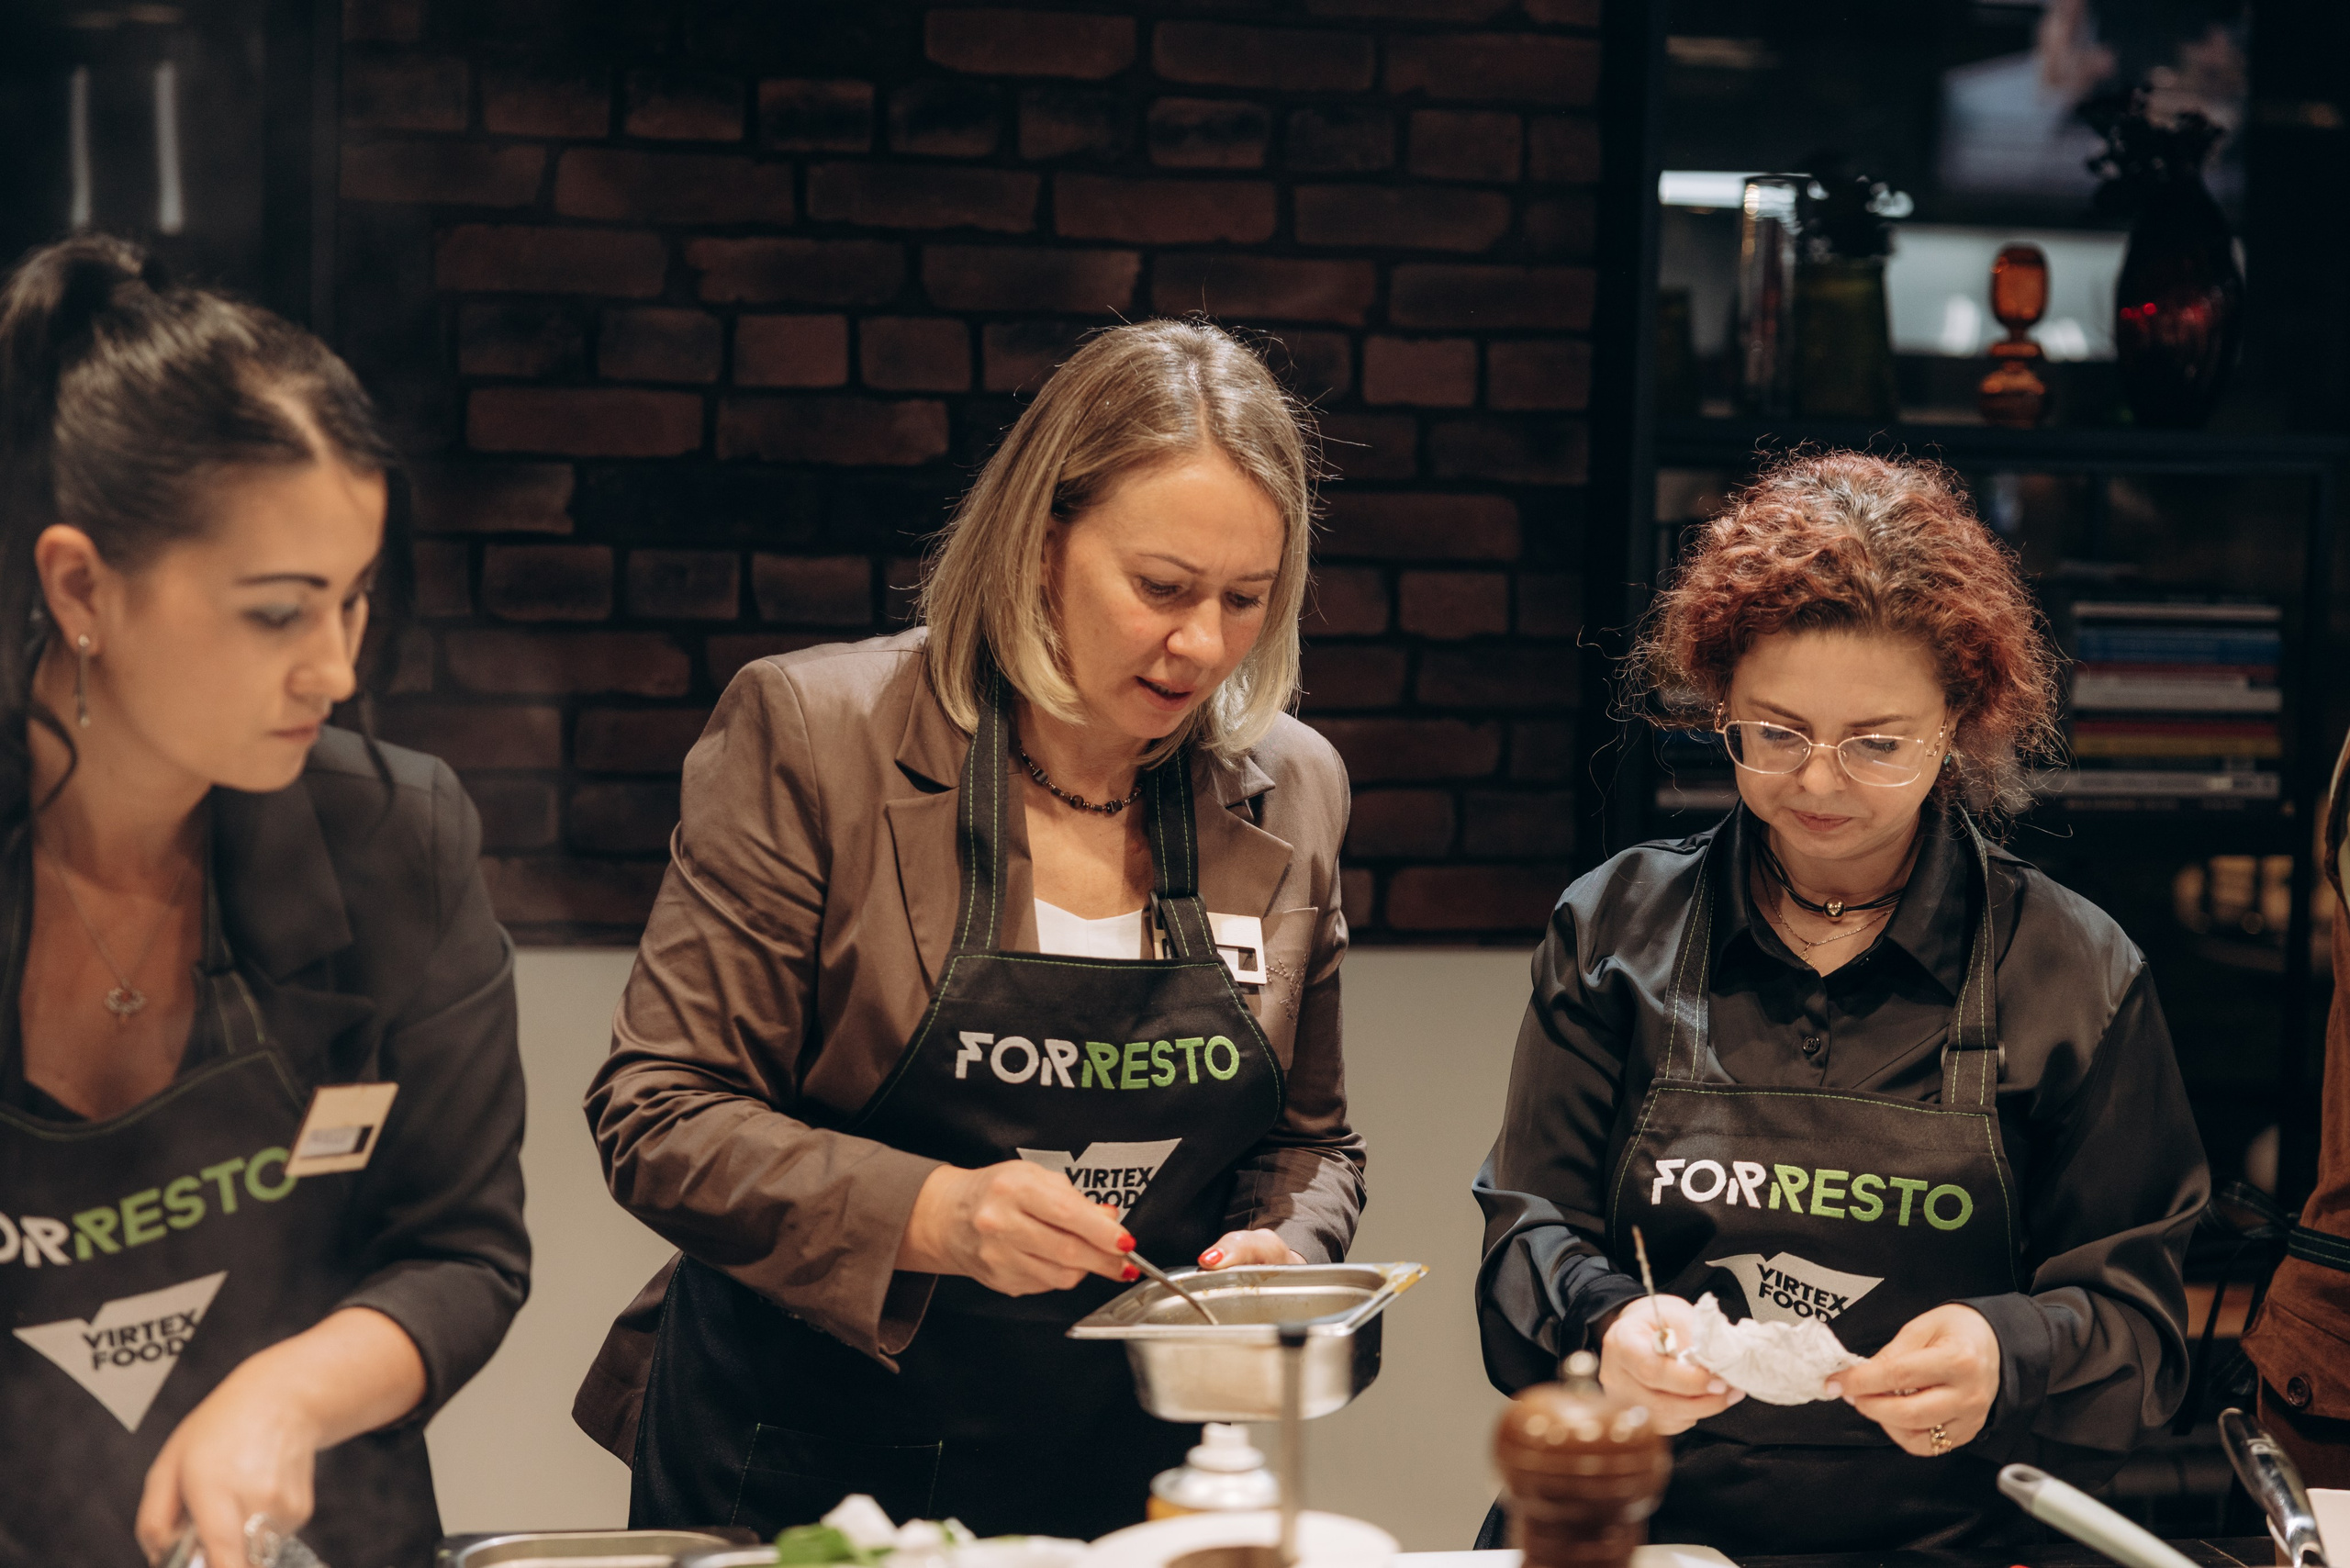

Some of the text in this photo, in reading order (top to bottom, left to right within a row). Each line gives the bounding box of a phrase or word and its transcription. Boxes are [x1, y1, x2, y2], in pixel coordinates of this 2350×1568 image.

[955, 1030, 1240, 1090] FORRESTO
[1065, 1166, 1154, 1188] VIRTEX
[1651, 1159, 1974, 1231] FORRESTO
[1082, 1190, 1140, 1208] OOD
[1756, 1262, 1849, 1314] VIRTEX
[1759, 1282, 1832, 1323] FOOD
[83, 1307, 196, 1349] VIRTEX
[94, 1336, 184, 1371] FOOD
